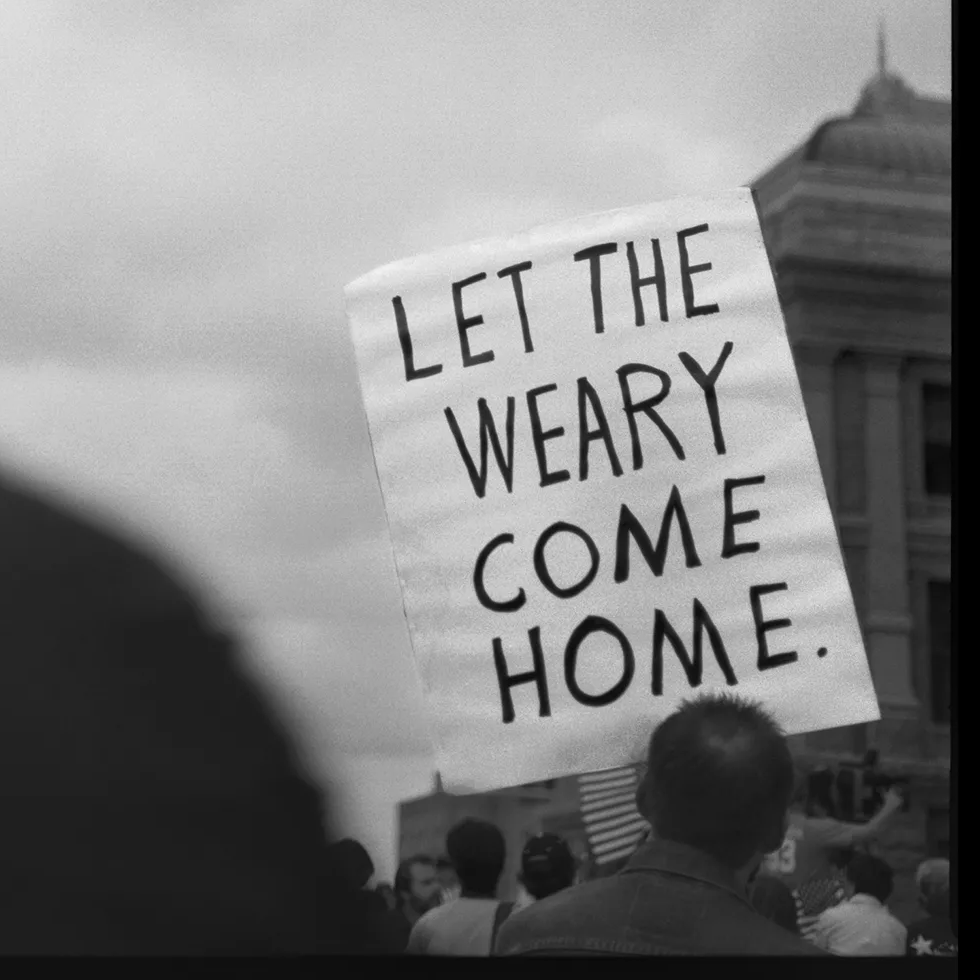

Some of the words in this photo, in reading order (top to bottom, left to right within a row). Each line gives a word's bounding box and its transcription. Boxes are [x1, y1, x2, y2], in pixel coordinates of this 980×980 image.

[391, 260, 534, 382] LET
[573, 223, 720, 334] THE
[443, 340, 734, 499] WEARY
[472, 474, 766, 613] COME
[491, 581, 828, 725] HOME.
